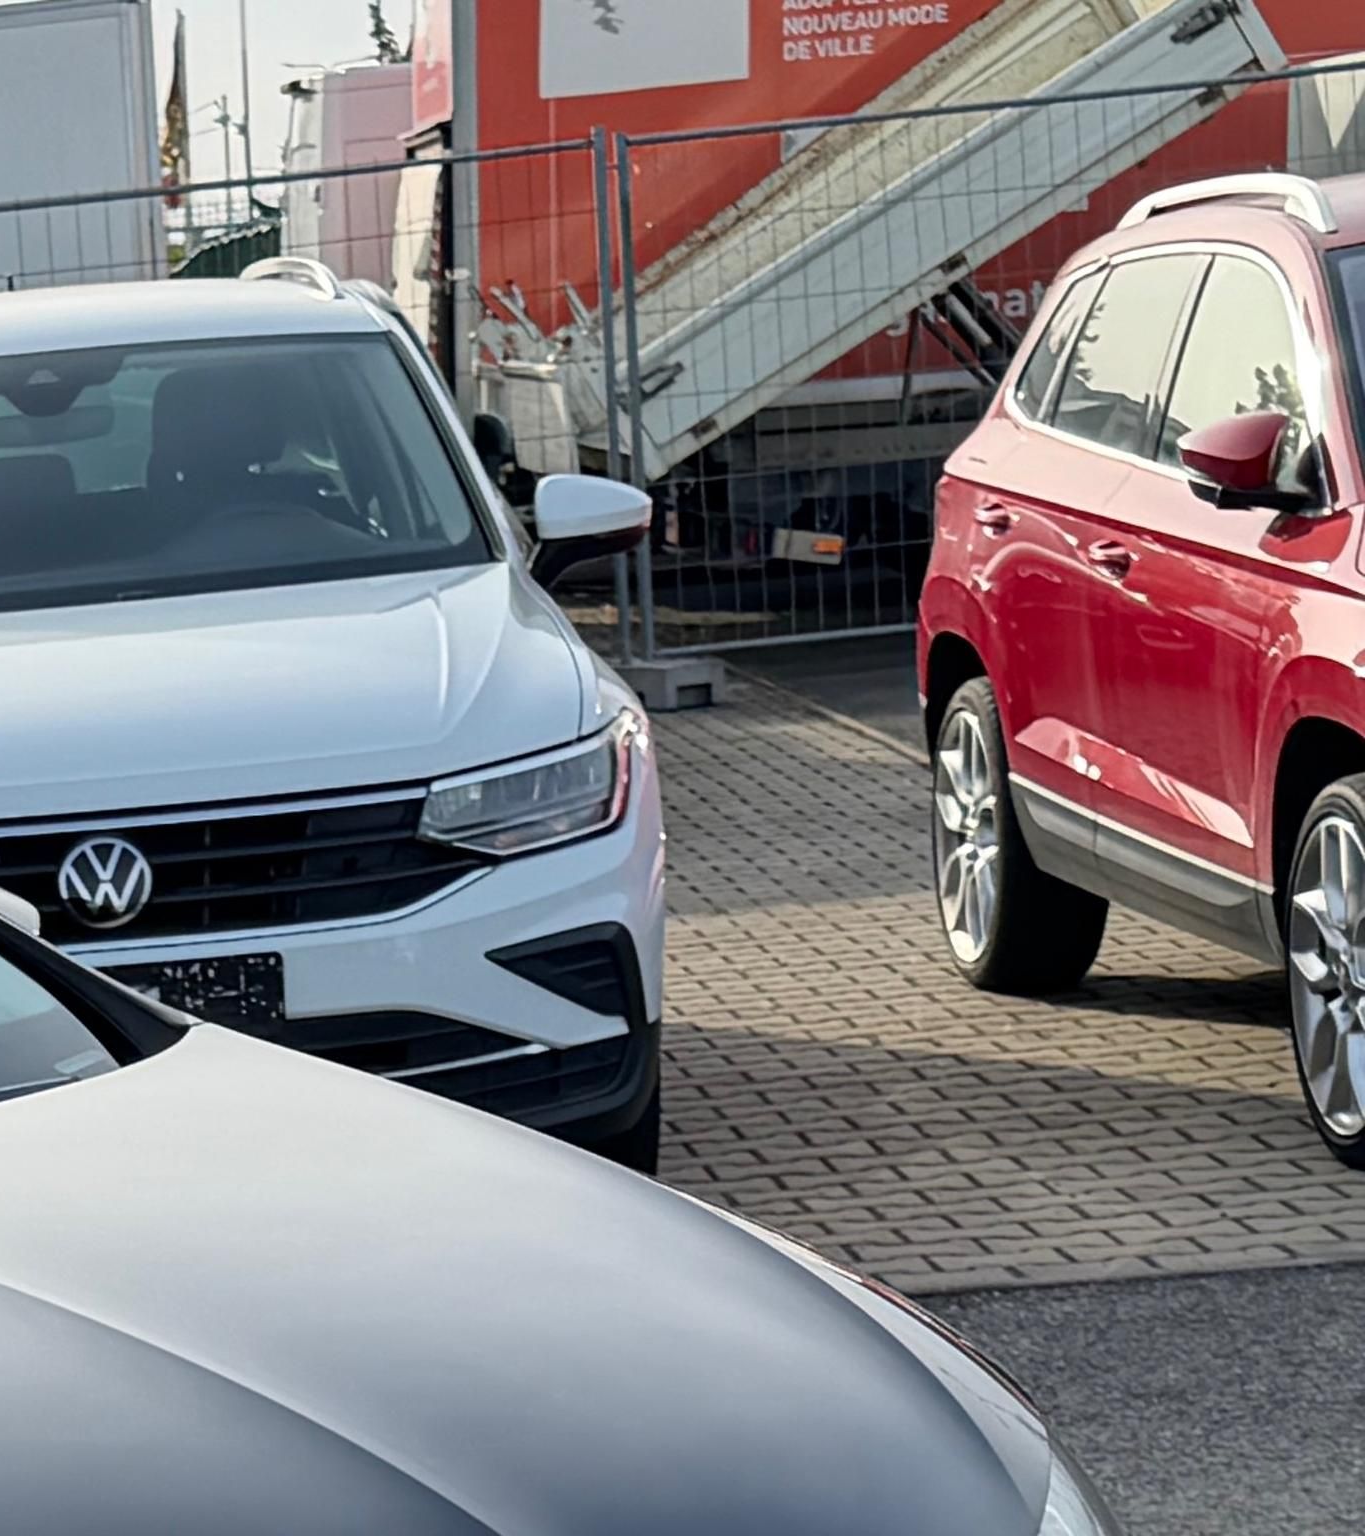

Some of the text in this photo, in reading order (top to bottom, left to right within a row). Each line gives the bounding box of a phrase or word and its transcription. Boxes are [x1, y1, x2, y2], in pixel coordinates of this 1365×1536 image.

[782, 9, 883, 36] NOUVEAU
[887, 4, 949, 27] MODE
[782, 35, 874, 62] DE VILLE
